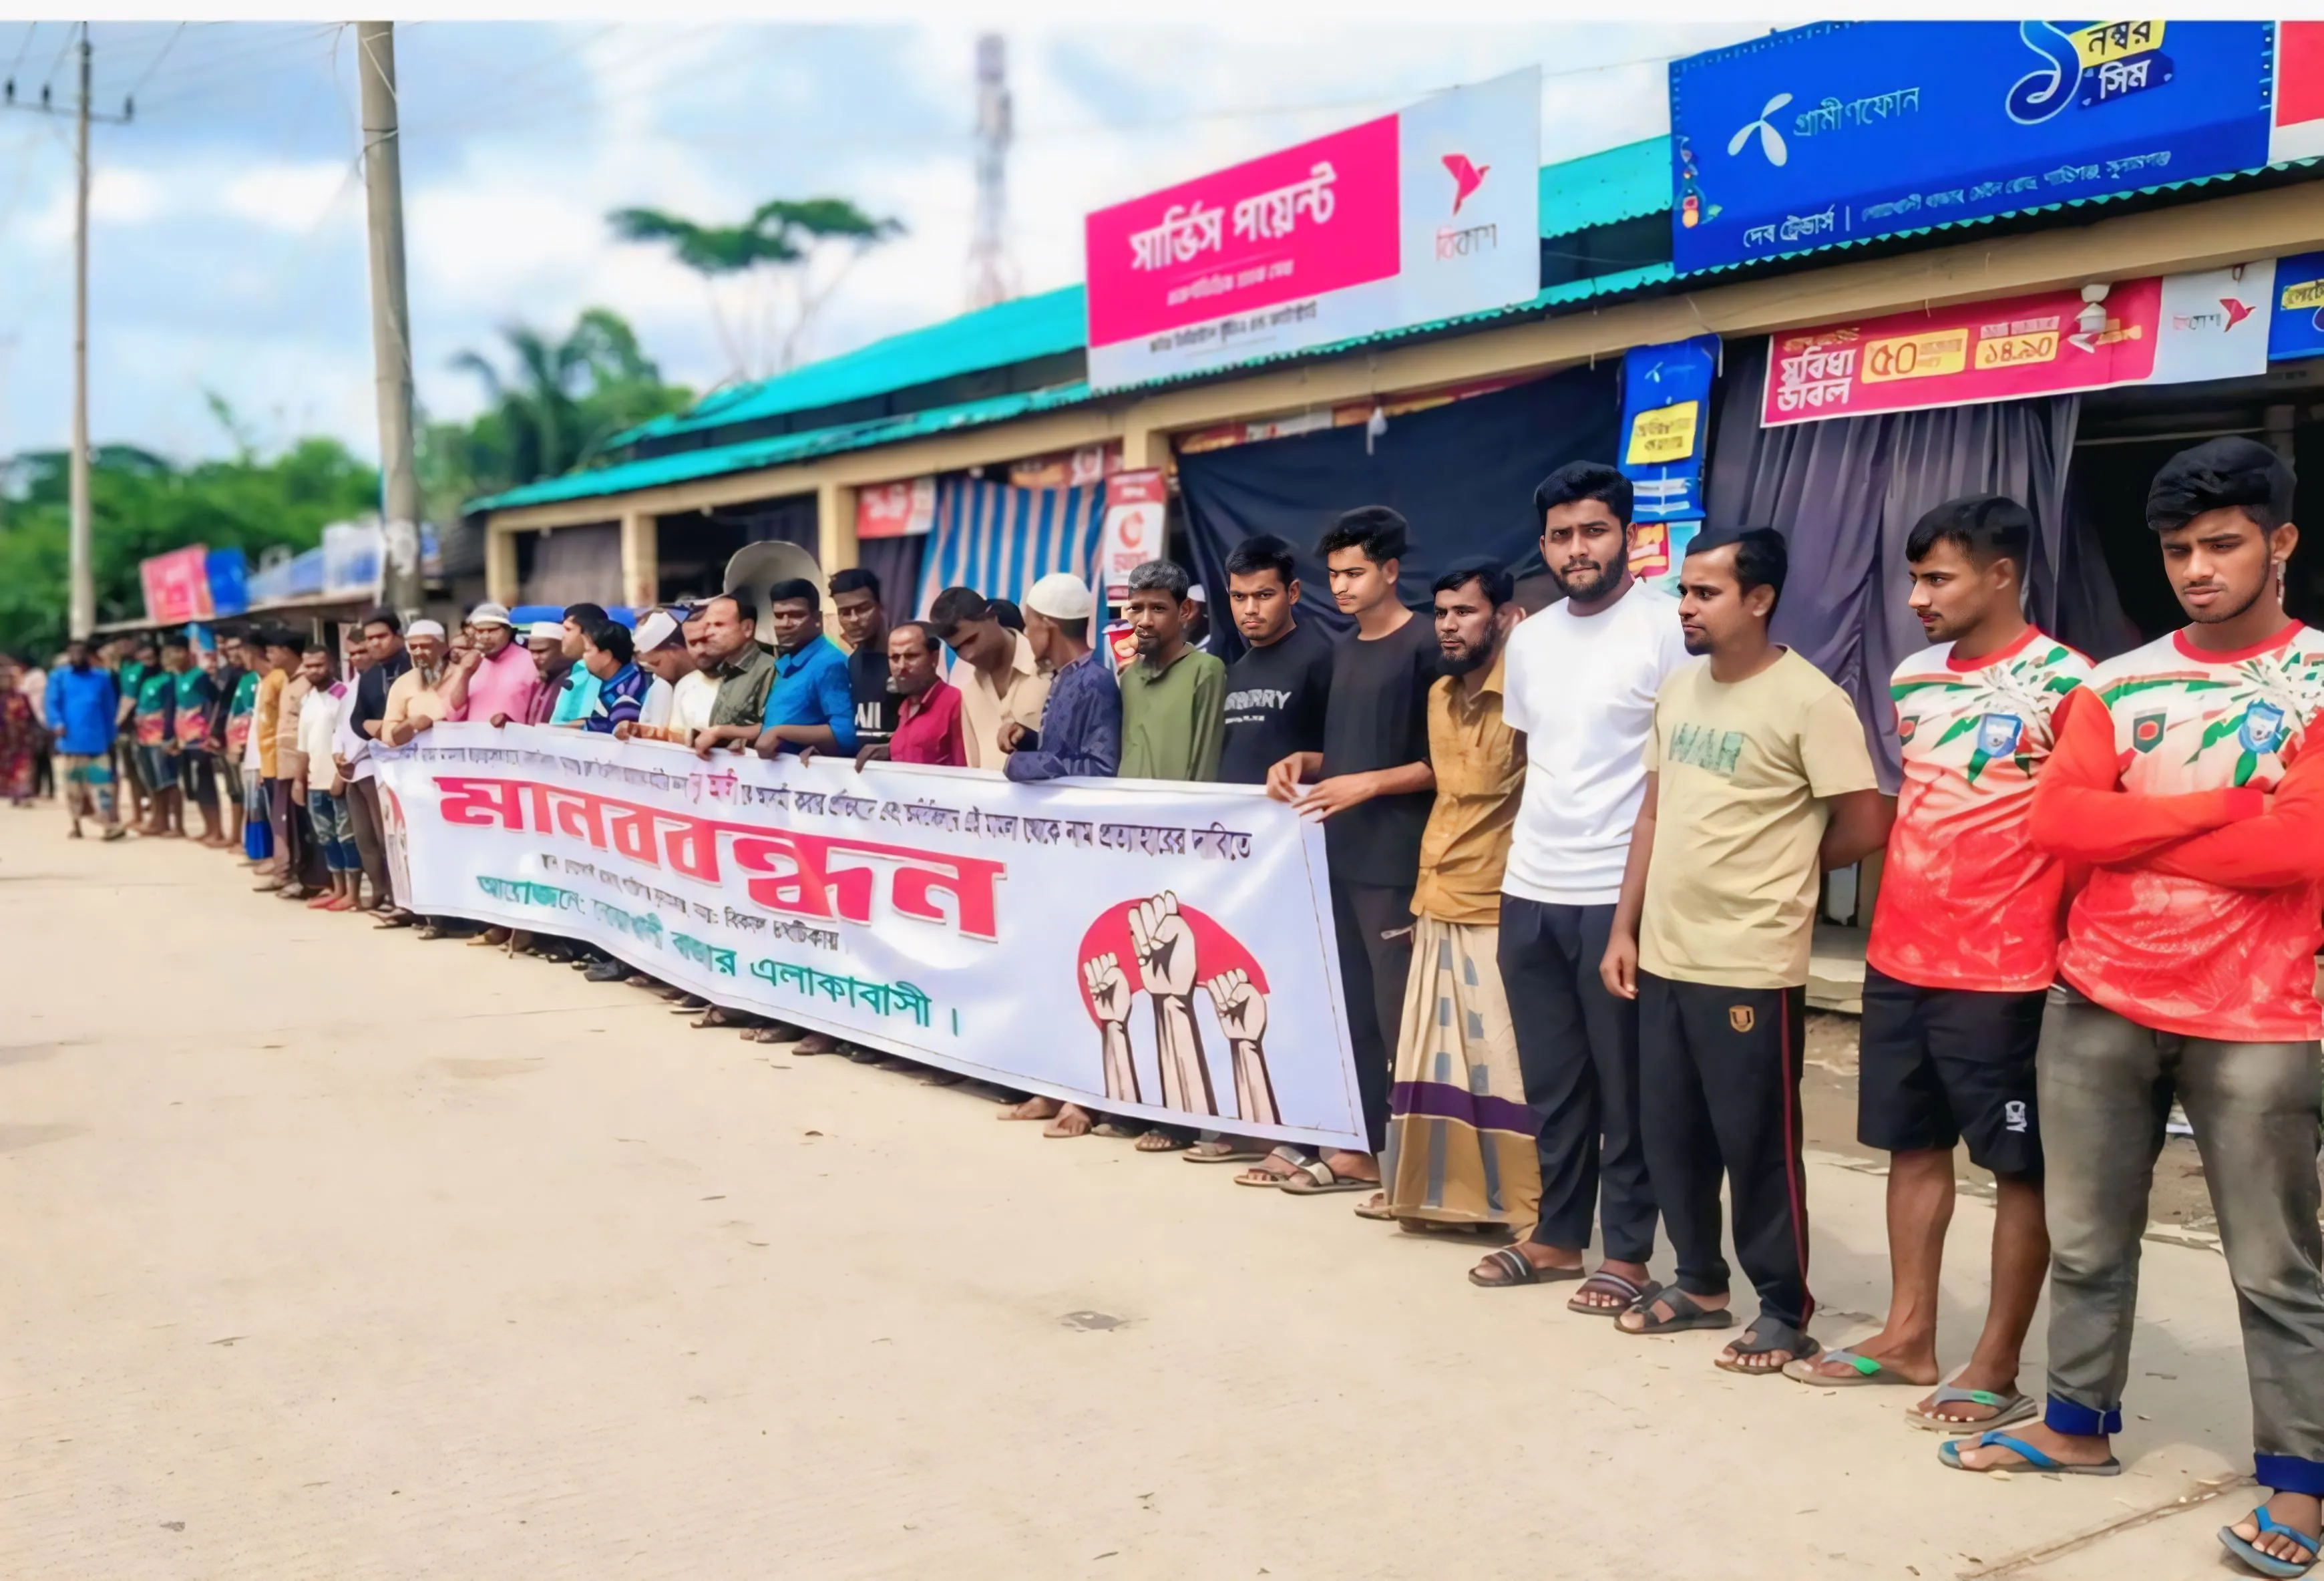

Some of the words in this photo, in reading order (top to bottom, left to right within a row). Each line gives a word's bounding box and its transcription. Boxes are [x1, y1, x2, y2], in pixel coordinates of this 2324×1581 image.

[2086, 21, 2151, 56] নম্বর
[2098, 59, 2152, 99] সিম
[1793, 87, 1920, 136] গ্রামীণফোন
[1129, 200, 1225, 271] সার্ভিস
[1233, 160, 1338, 242] পয়েন্ট
[1743, 224, 1776, 248] দেব
[1780, 345, 1857, 385] সুবিধা
[1869, 341, 1917, 376] ৫০
[1776, 376, 1853, 411] ডাবল
[431, 776, 1008, 944] মানববন্ধন
[749, 958, 933, 1028] এলাকাবাসী
